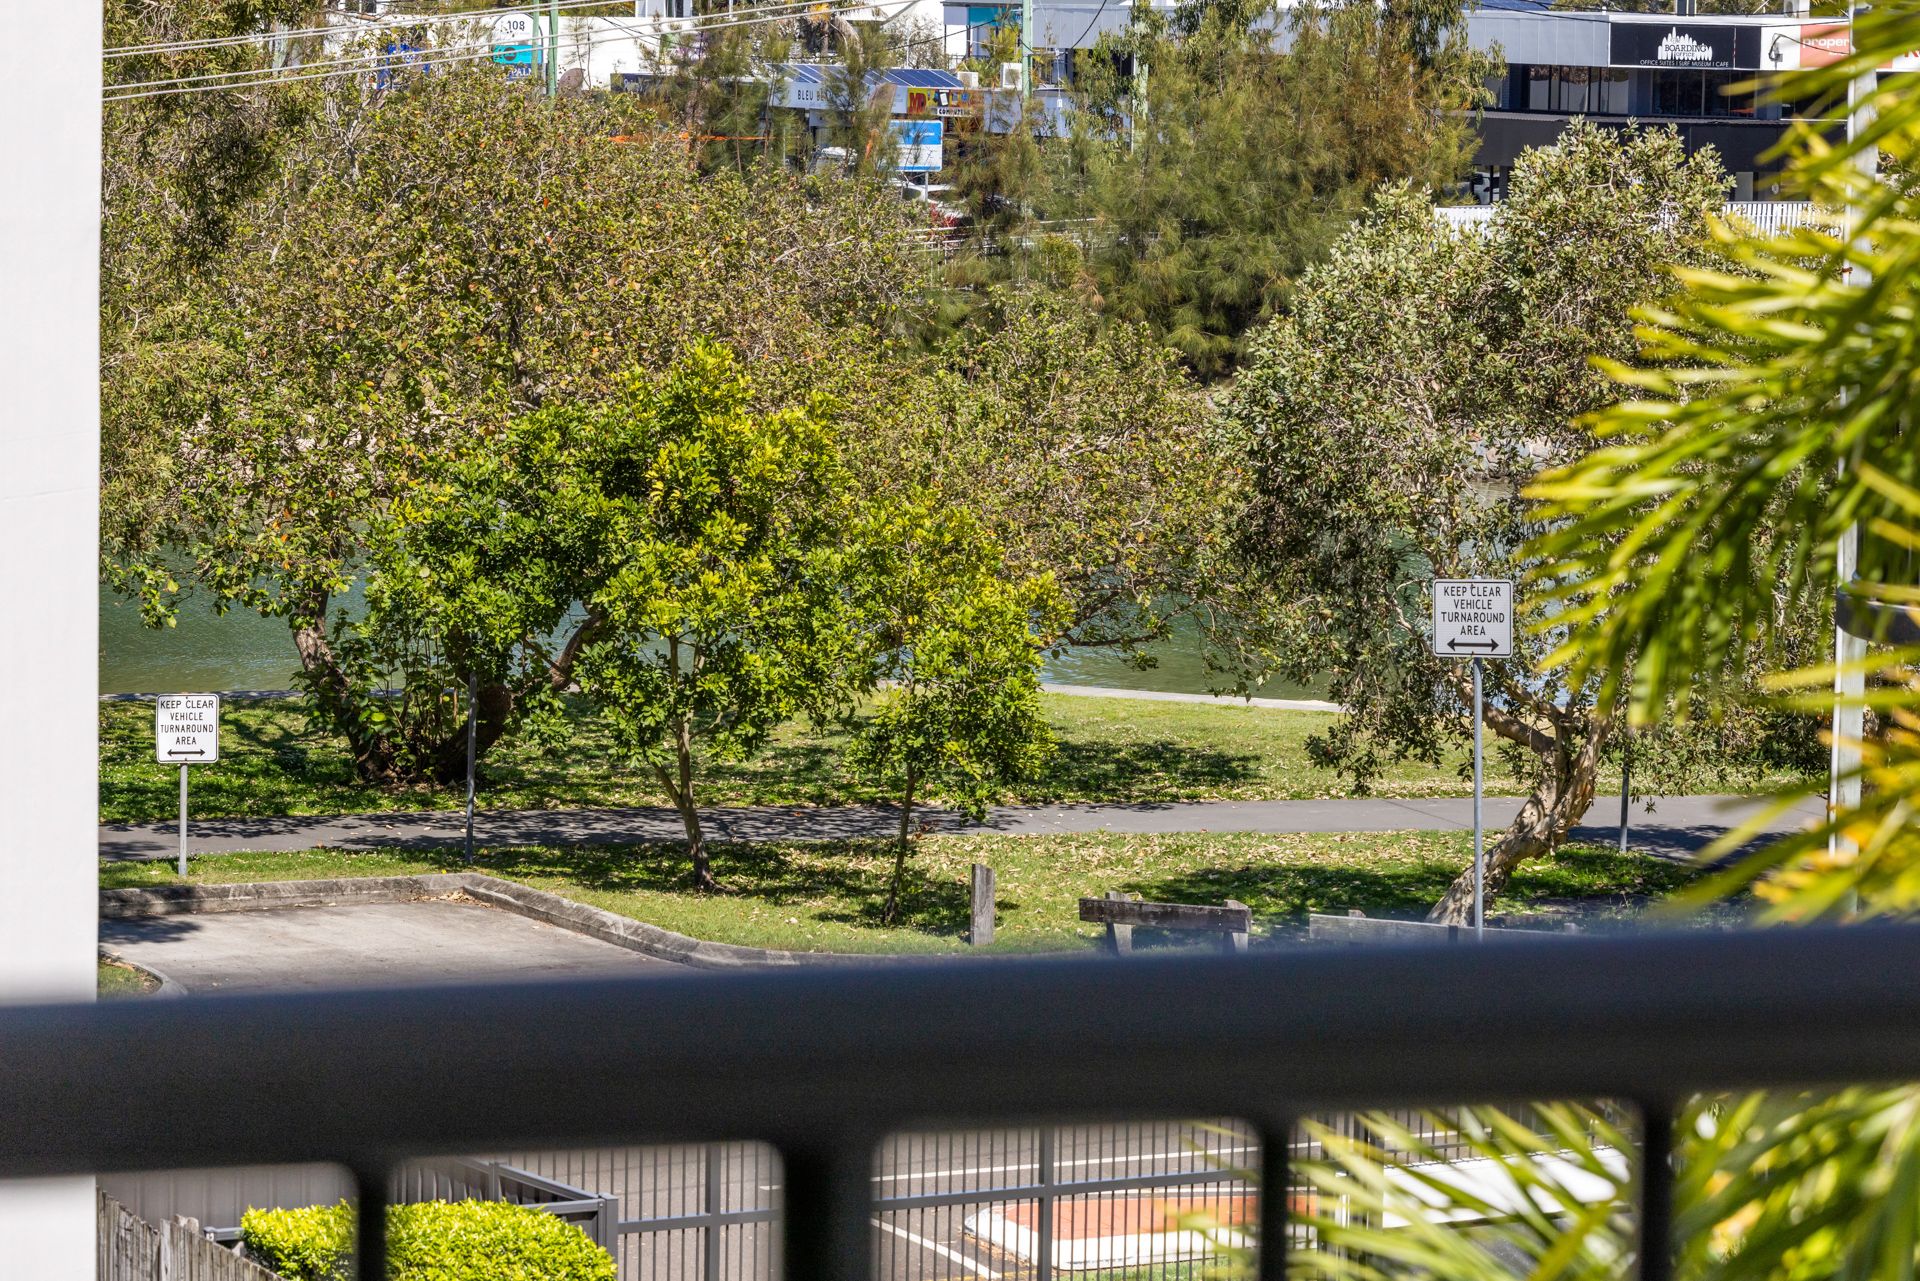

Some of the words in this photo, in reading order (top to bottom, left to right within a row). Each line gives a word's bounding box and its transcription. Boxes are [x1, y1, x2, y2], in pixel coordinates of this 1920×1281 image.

[508, 21, 525, 31] 108
[1664, 44, 1707, 52] BOARDING
[1802, 38, 1849, 48] proper
[797, 90, 814, 101] BLEU
[1443, 586, 1467, 597] KEEP
[1470, 586, 1502, 597] CLEAR
[1453, 599, 1493, 610] VEHICLE
[1441, 612, 1505, 623] TURNAROUND
[1460, 625, 1486, 636] AREA
[160, 700, 182, 709] KEEP
[185, 700, 214, 709] CLEAR
[170, 712, 204, 721] VEHICLE
[160, 724, 214, 733] TURNAROUND
[175, 736, 197, 745] AREA
